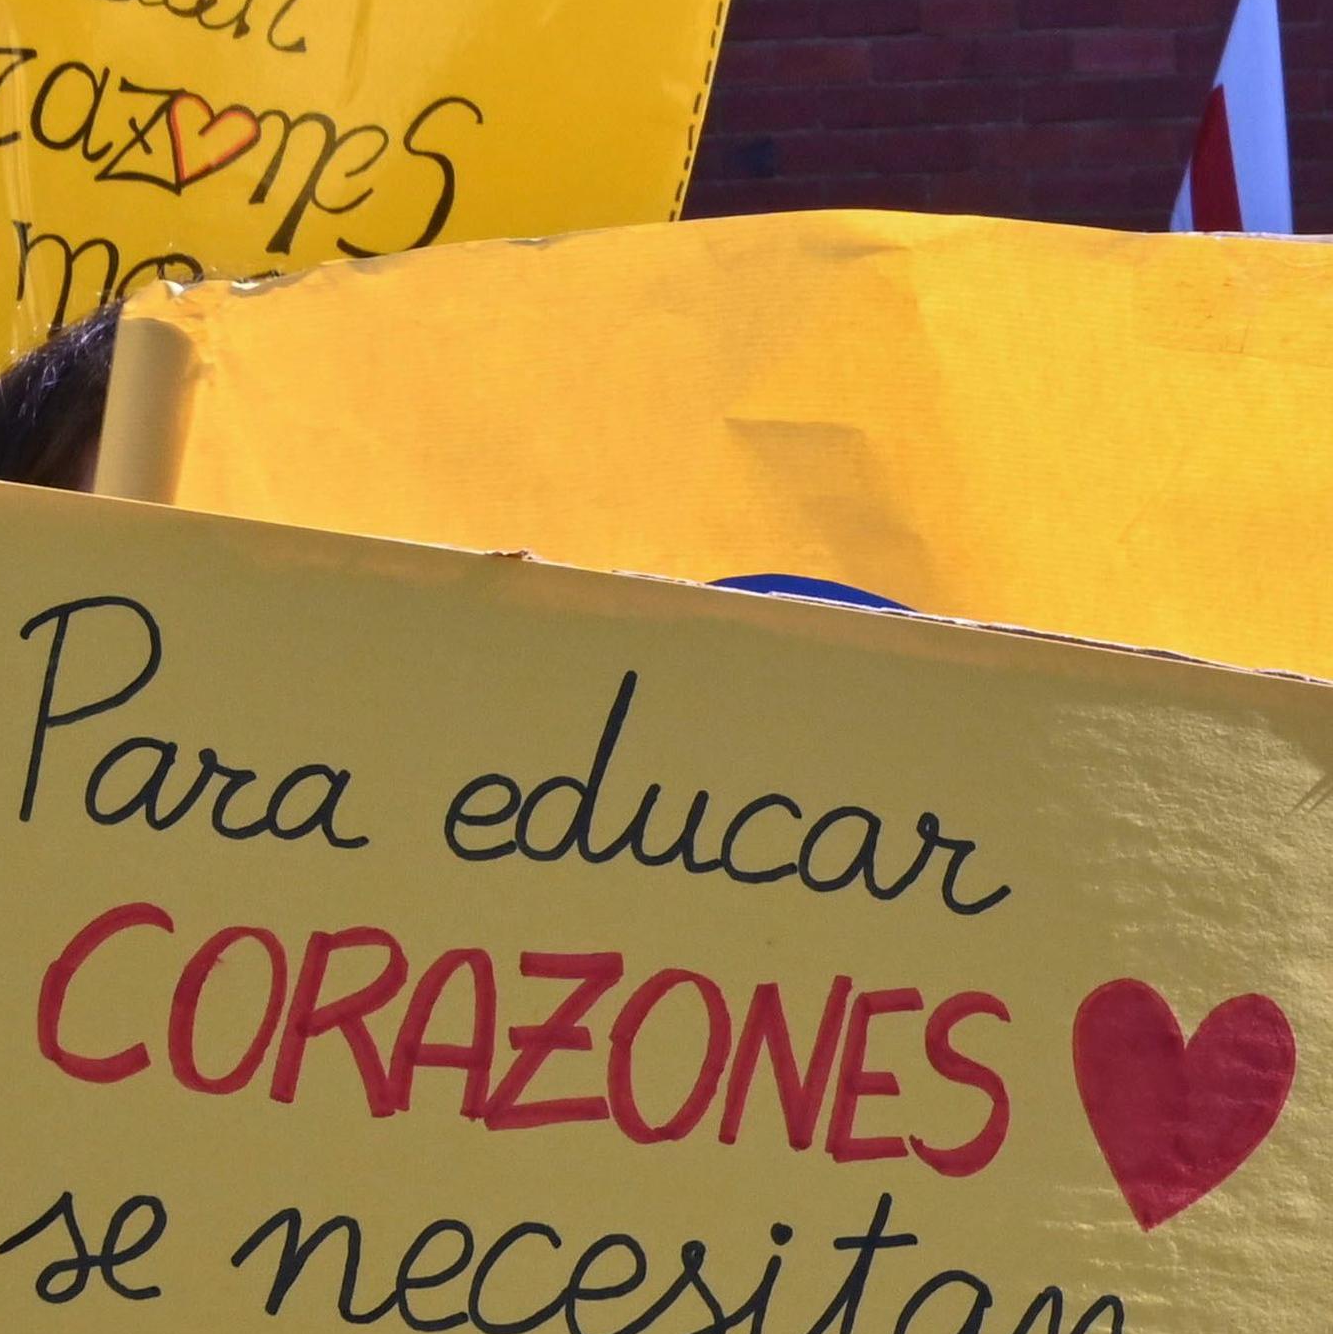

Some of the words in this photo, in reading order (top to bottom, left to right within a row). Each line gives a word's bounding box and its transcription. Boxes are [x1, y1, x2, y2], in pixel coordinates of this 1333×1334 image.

[19, 596, 370, 849] Para
[443, 670, 1012, 916] educar
[38, 902, 1011, 1177] CORAZONES
